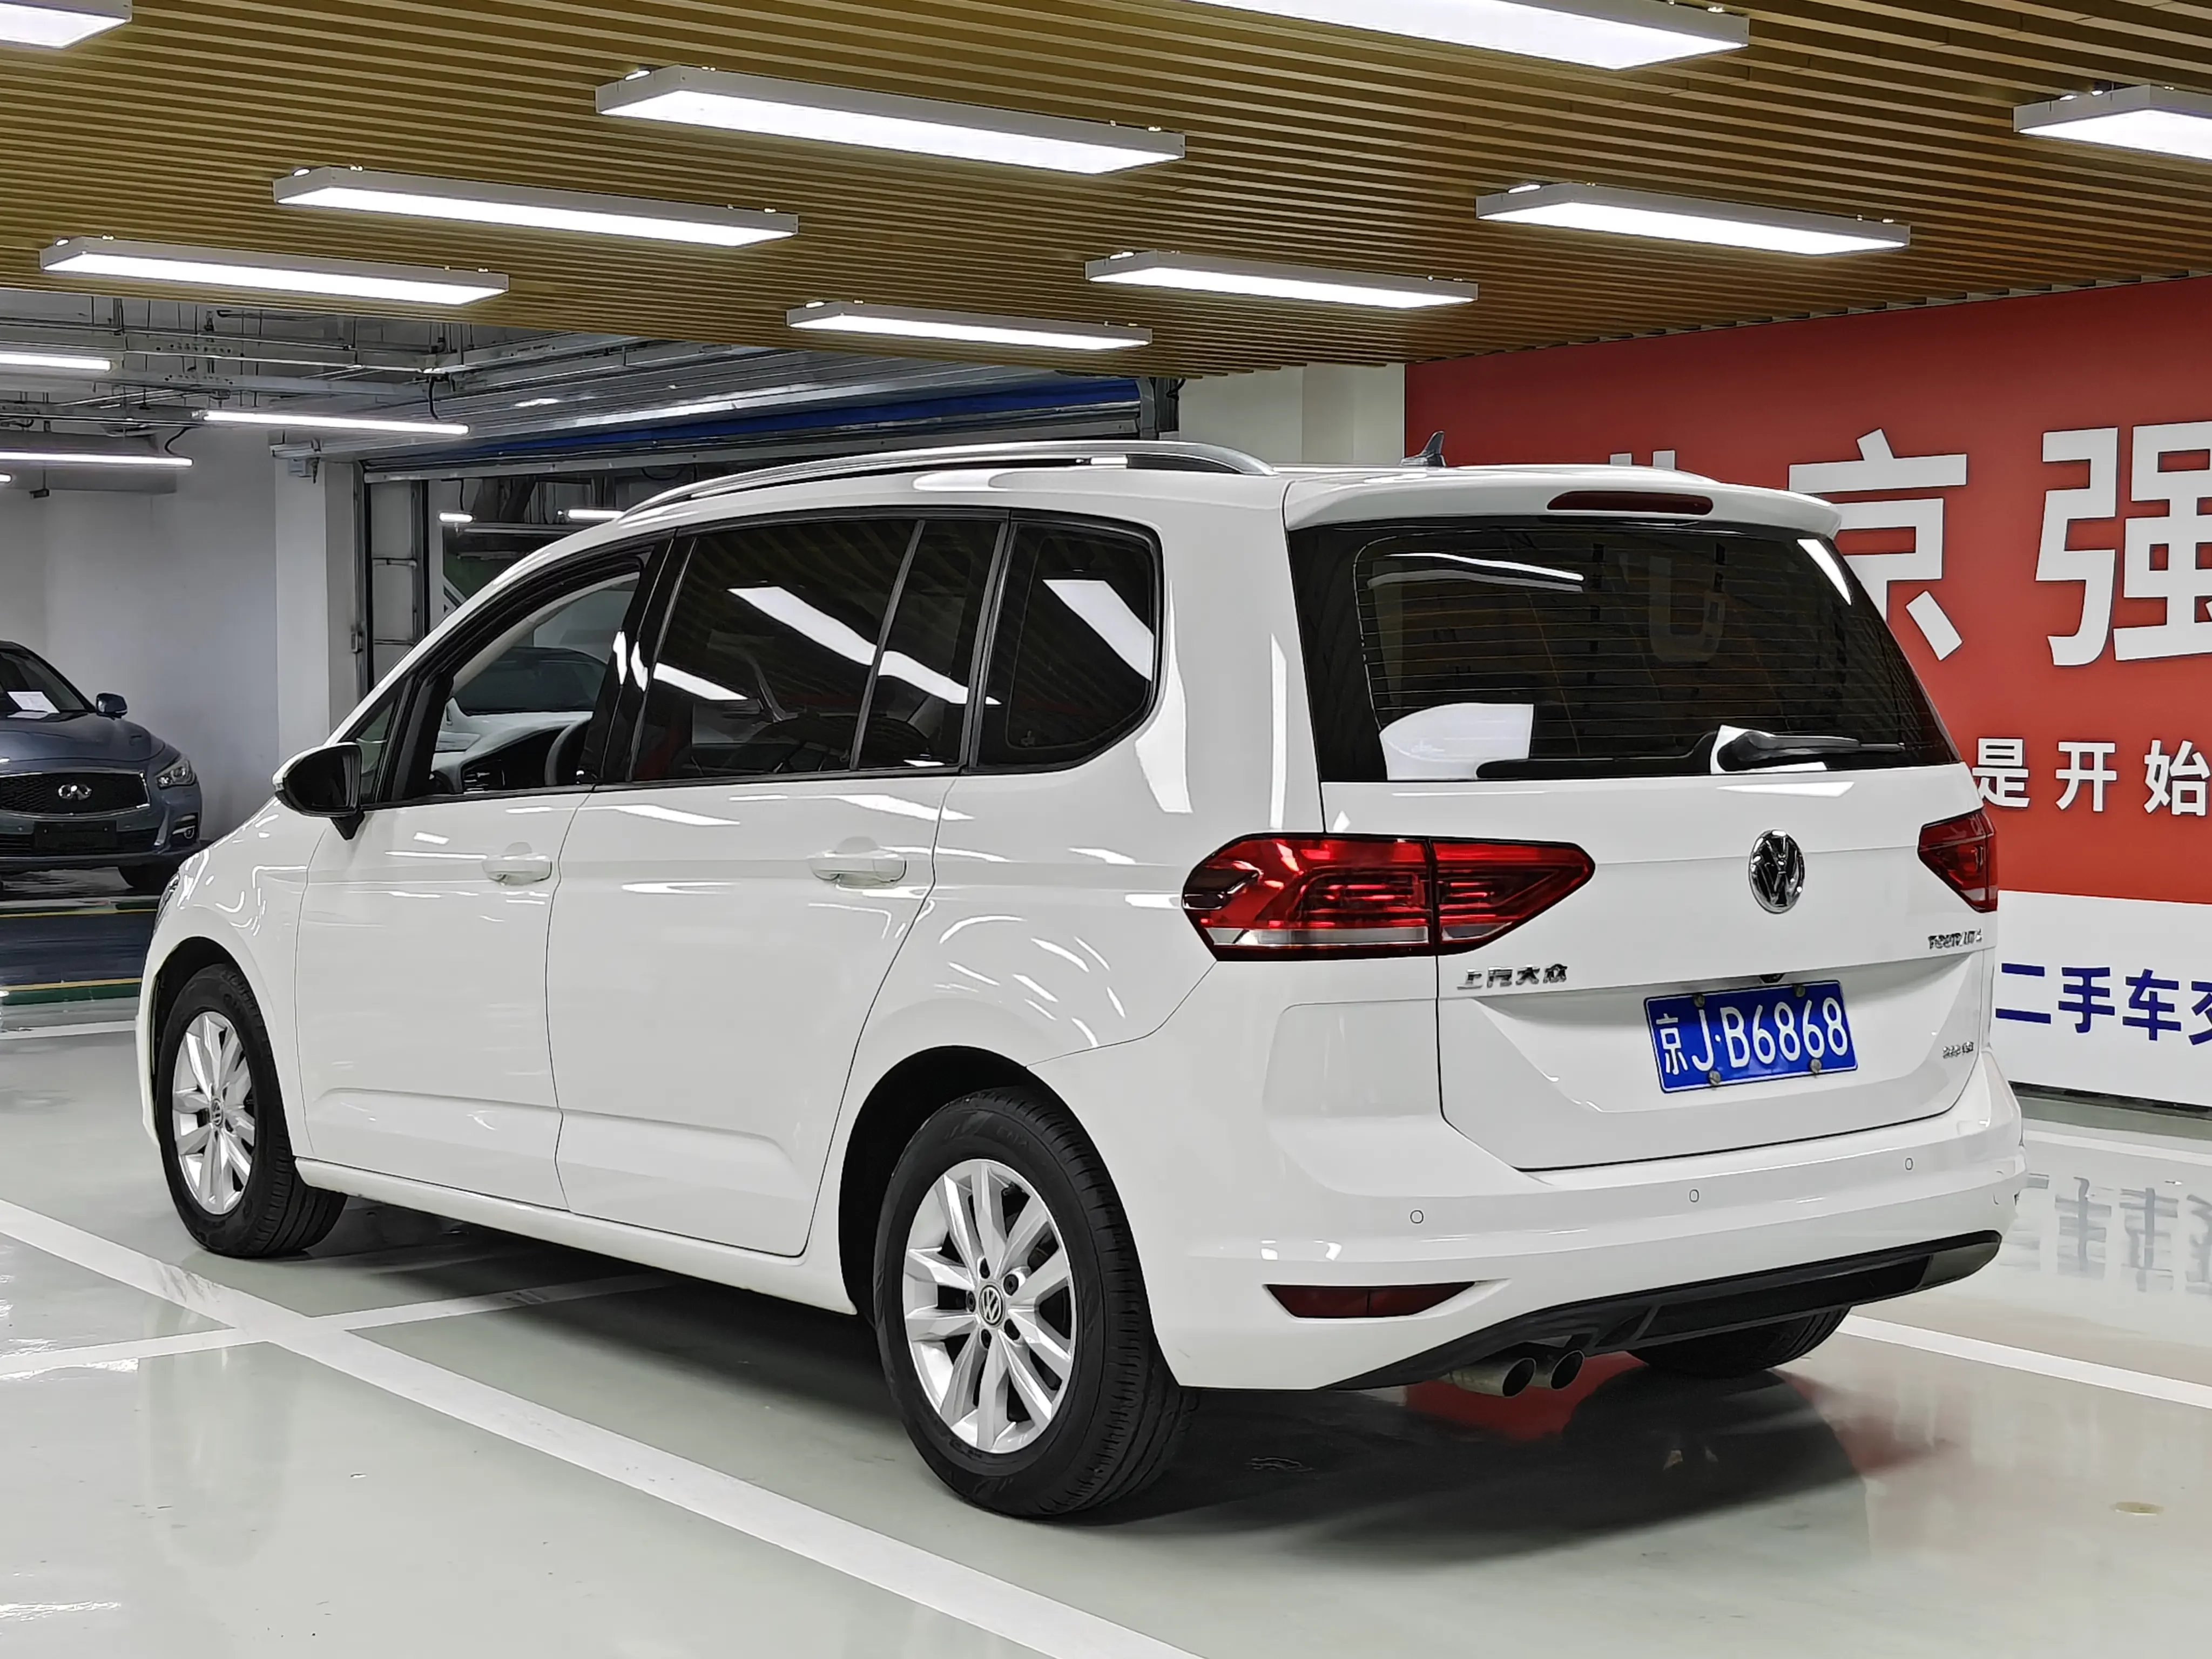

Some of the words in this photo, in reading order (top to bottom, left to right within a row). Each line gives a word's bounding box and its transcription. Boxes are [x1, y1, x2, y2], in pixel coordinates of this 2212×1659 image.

[1609, 421, 2212, 666] 京强
[1972, 738, 2211, 817] 是开始
